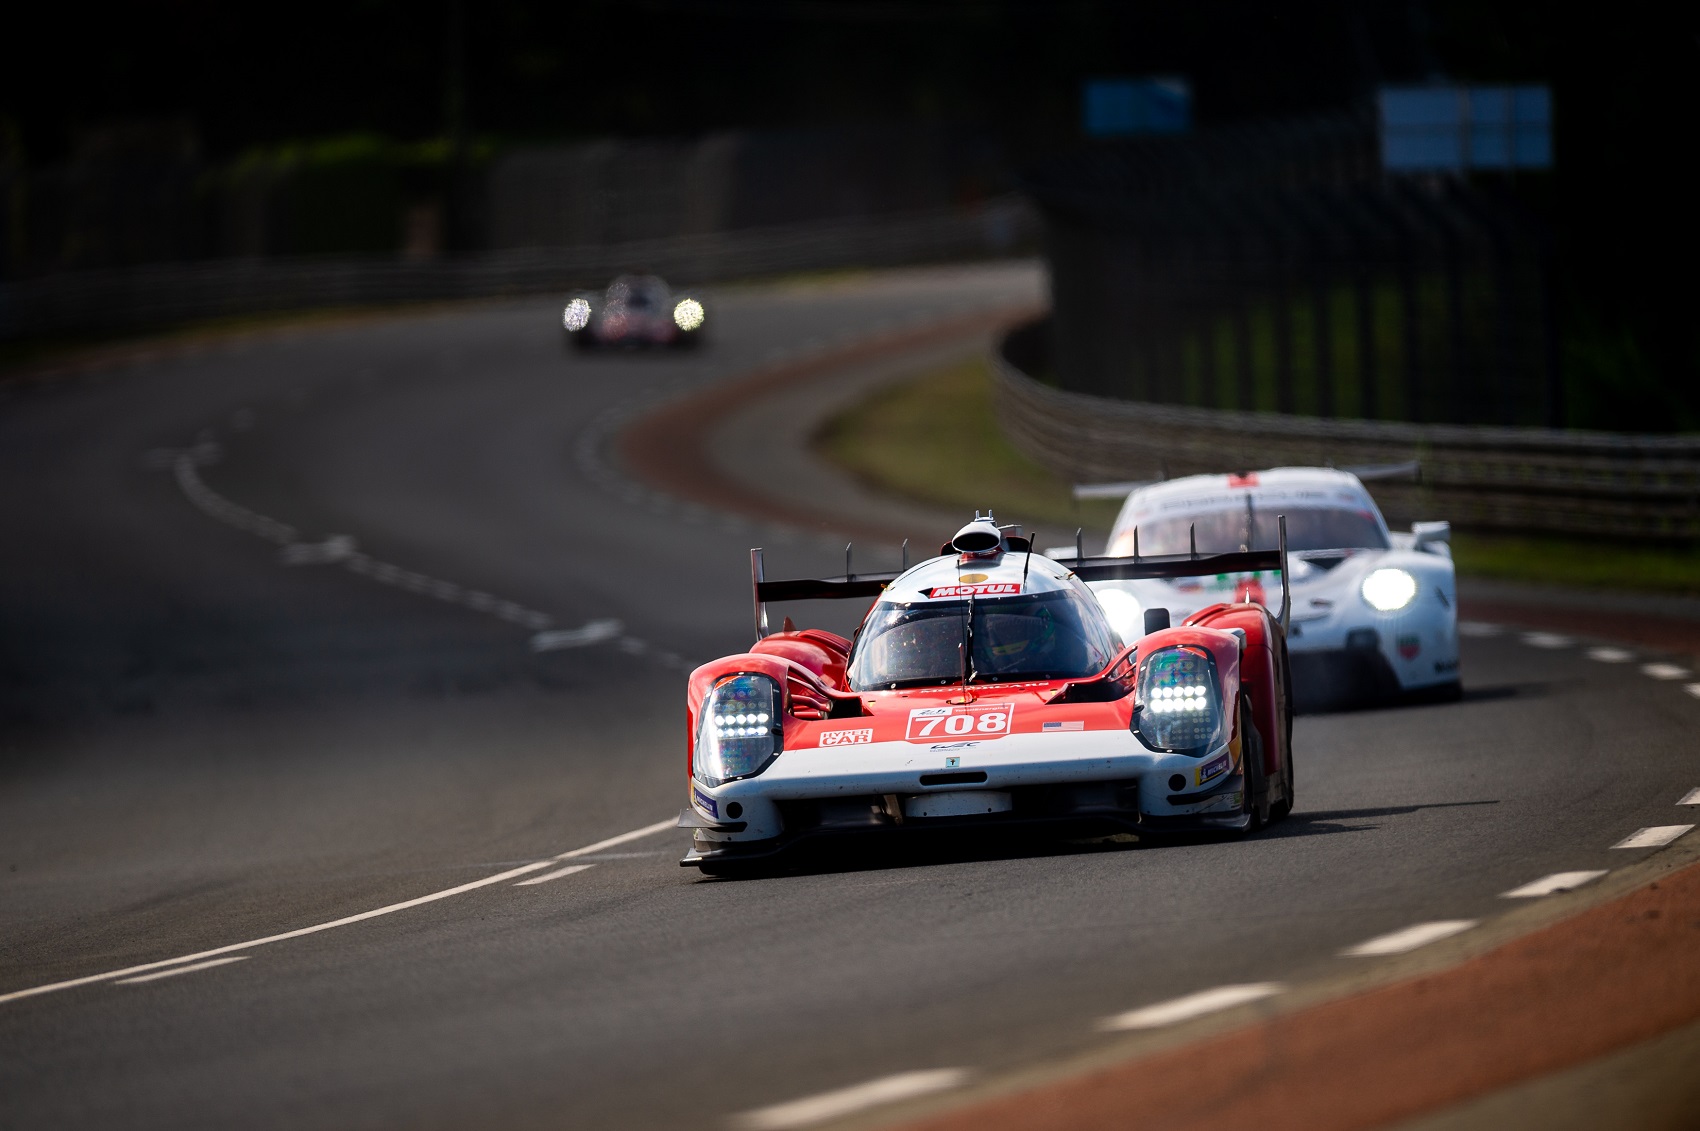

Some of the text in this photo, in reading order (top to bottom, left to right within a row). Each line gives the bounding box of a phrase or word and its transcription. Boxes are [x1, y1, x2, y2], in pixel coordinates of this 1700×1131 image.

[932, 584, 1017, 598] MOTUL
[914, 712, 1007, 737] 708
[823, 729, 870, 738] HYPER
[822, 735, 869, 746] CAR
